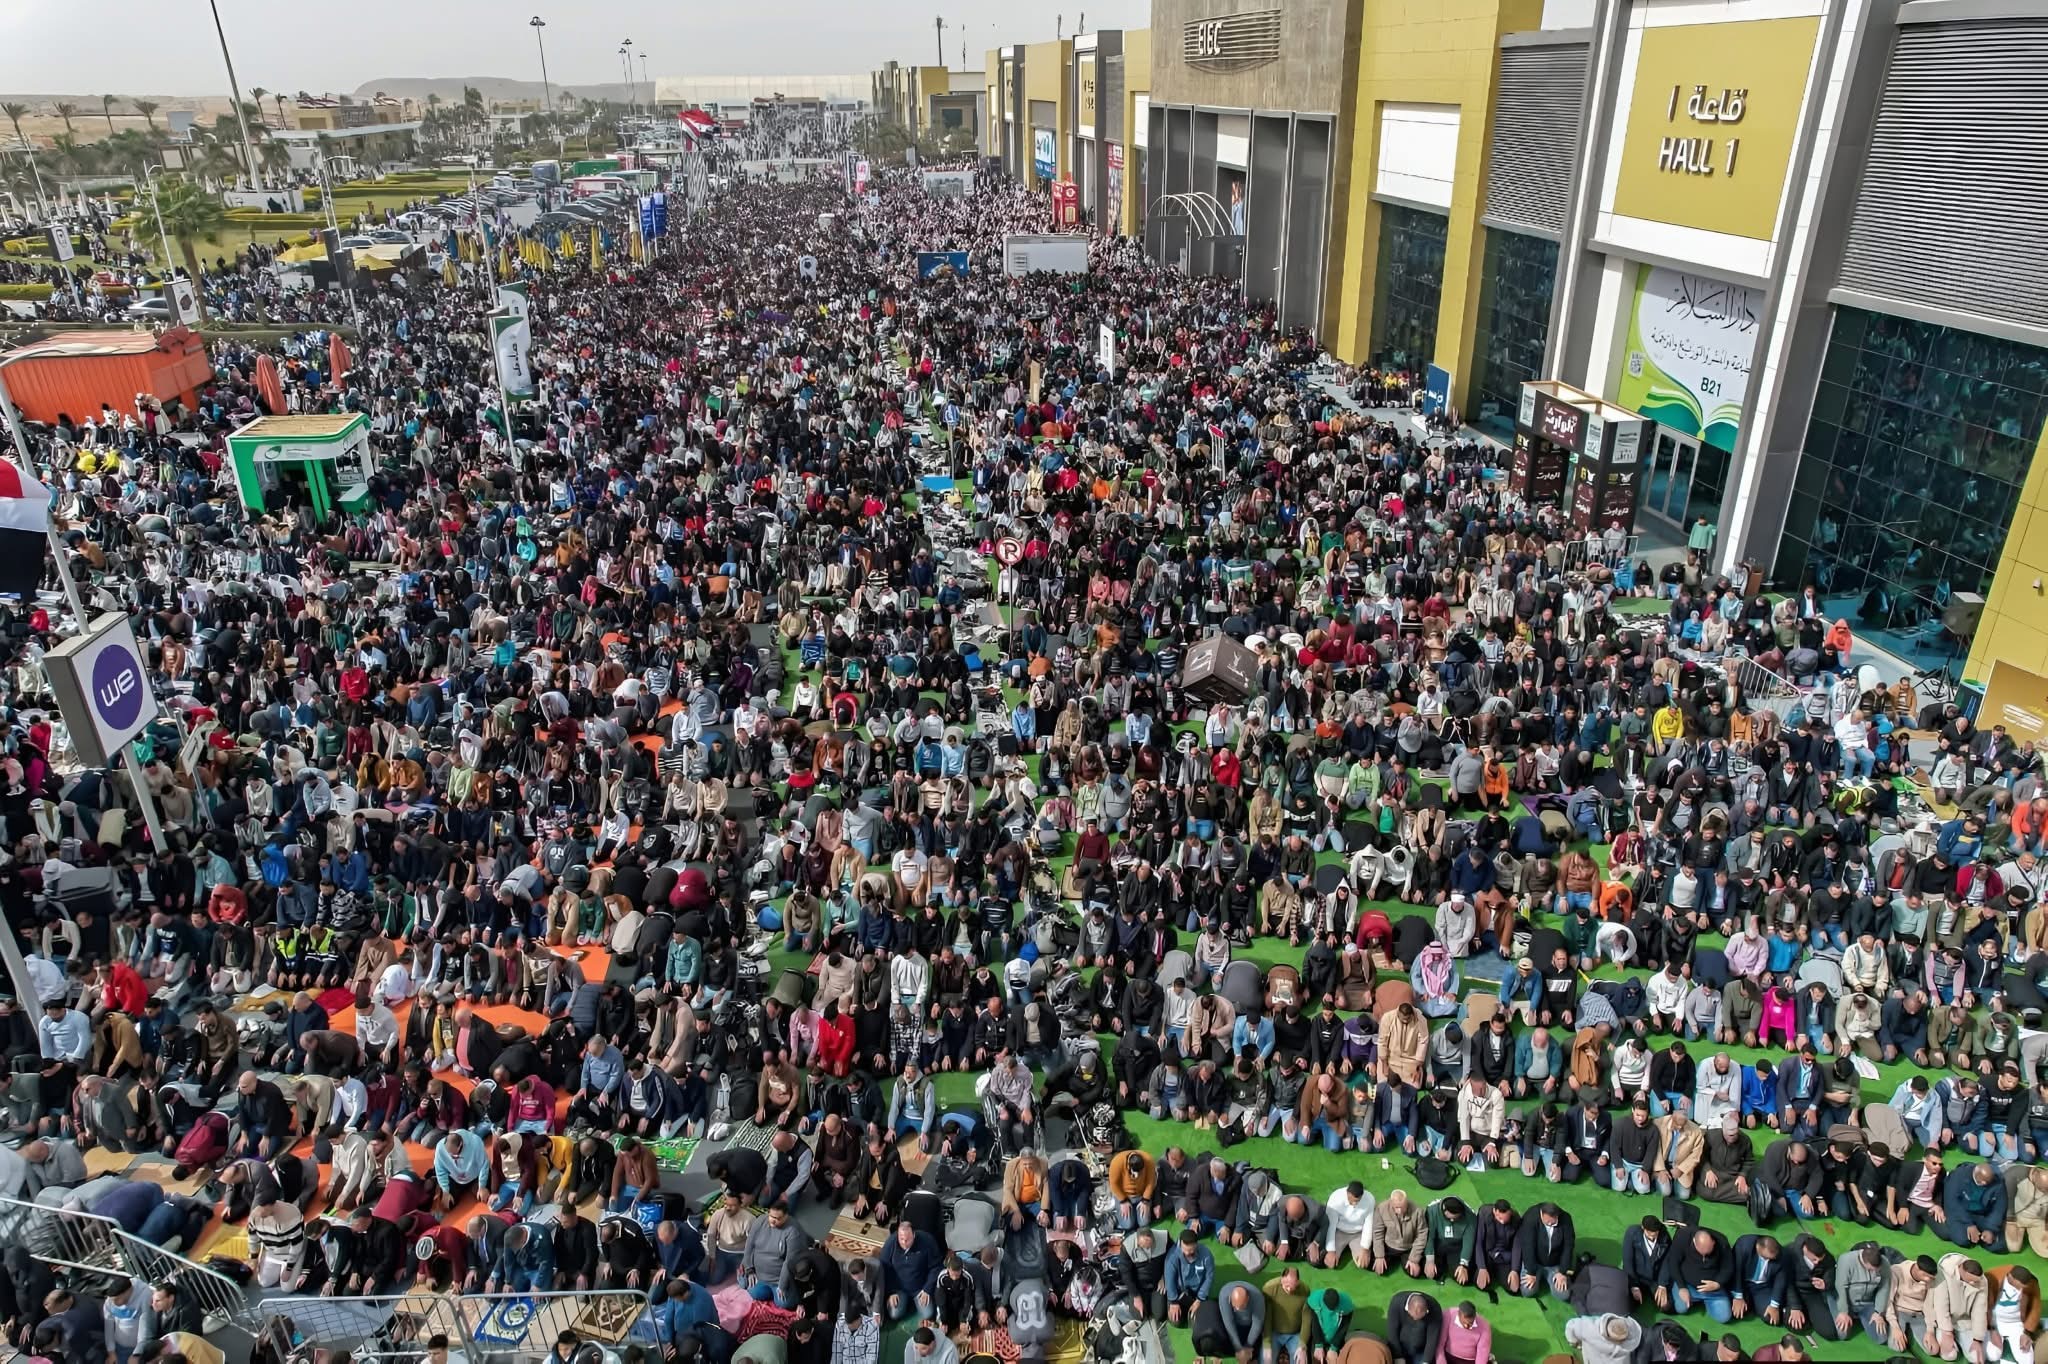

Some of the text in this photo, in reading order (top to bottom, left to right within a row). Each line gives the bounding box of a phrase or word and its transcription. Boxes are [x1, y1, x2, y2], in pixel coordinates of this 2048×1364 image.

[1687, 85, 1747, 123] قاعة
[1659, 137, 1740, 177] HALL 1
[1700, 377, 1722, 397] B21
